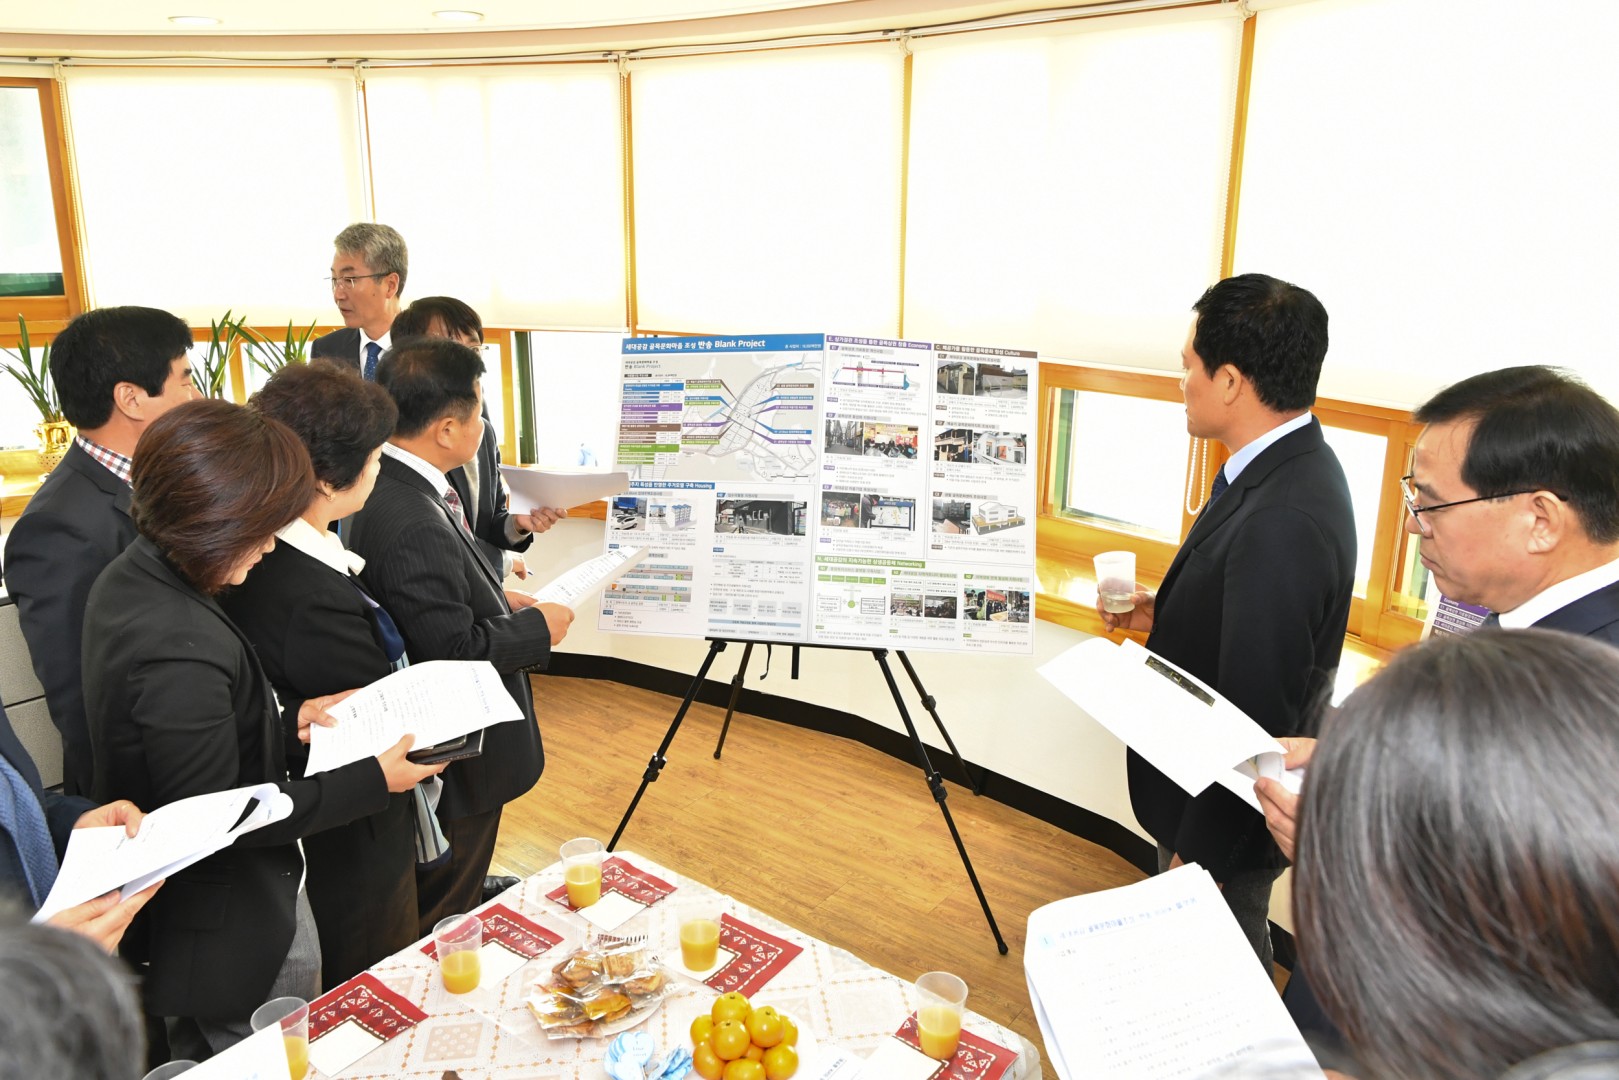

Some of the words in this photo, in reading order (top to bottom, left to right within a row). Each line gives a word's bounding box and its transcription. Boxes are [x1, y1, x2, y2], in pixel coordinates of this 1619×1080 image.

[626, 342, 648, 350] 세대공감
[698, 340, 713, 350] 반송
[714, 340, 736, 348] Blank
[738, 339, 766, 349] Project
